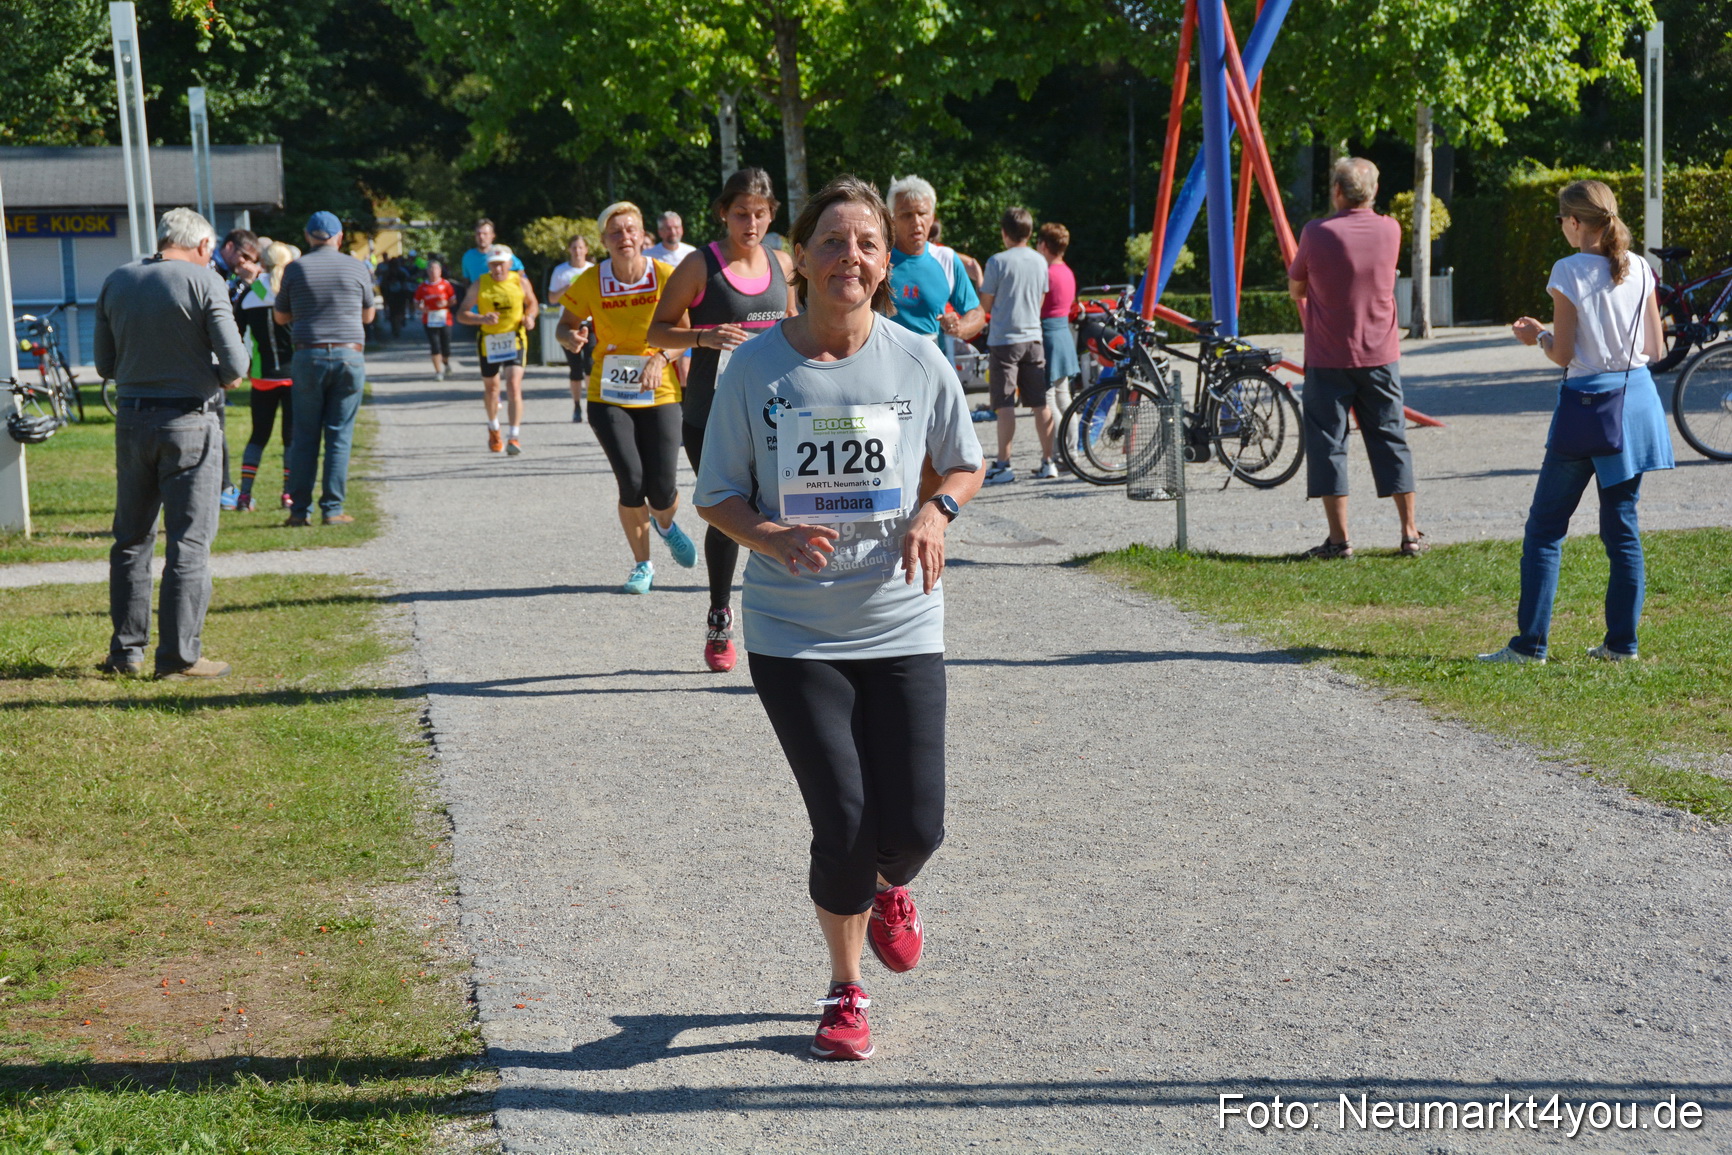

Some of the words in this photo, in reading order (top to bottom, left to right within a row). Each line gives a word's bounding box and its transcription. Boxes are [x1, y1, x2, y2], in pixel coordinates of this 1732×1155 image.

[4, 215, 38, 232] AFE
[602, 299, 627, 309] MAX
[631, 295, 660, 306] BÖGL
[491, 340, 512, 350] 2137
[610, 369, 641, 384] 242
[813, 417, 866, 431] BOCK
[797, 438, 886, 477] 2128
[806, 481, 832, 489] PARTL
[834, 480, 870, 488] Neumarkt
[815, 496, 874, 511] Barbara
[830, 550, 888, 571] Stadtlauf
